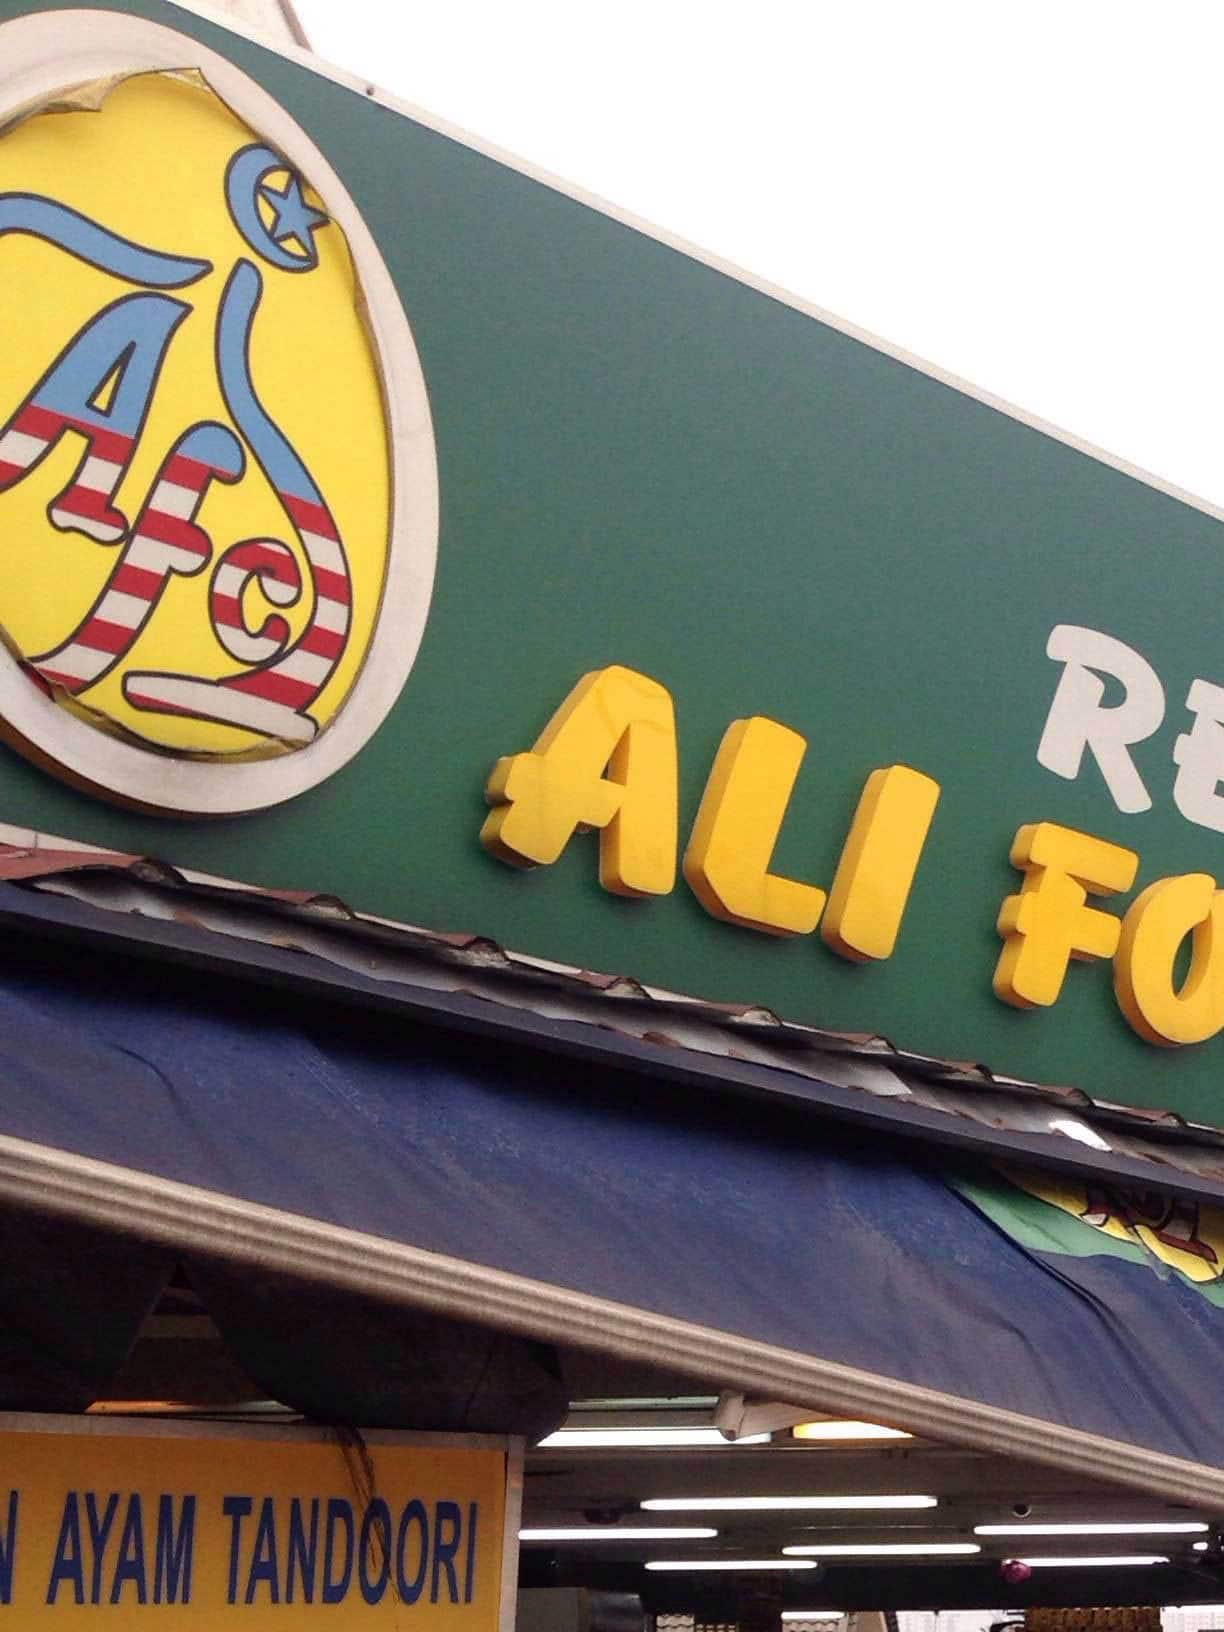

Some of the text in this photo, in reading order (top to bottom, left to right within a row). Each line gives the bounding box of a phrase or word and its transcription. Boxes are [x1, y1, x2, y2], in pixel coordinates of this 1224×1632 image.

[480, 664, 941, 963] ALI
[46, 1491, 196, 1605] AYAM
[223, 1496, 478, 1605] TANDOORI
